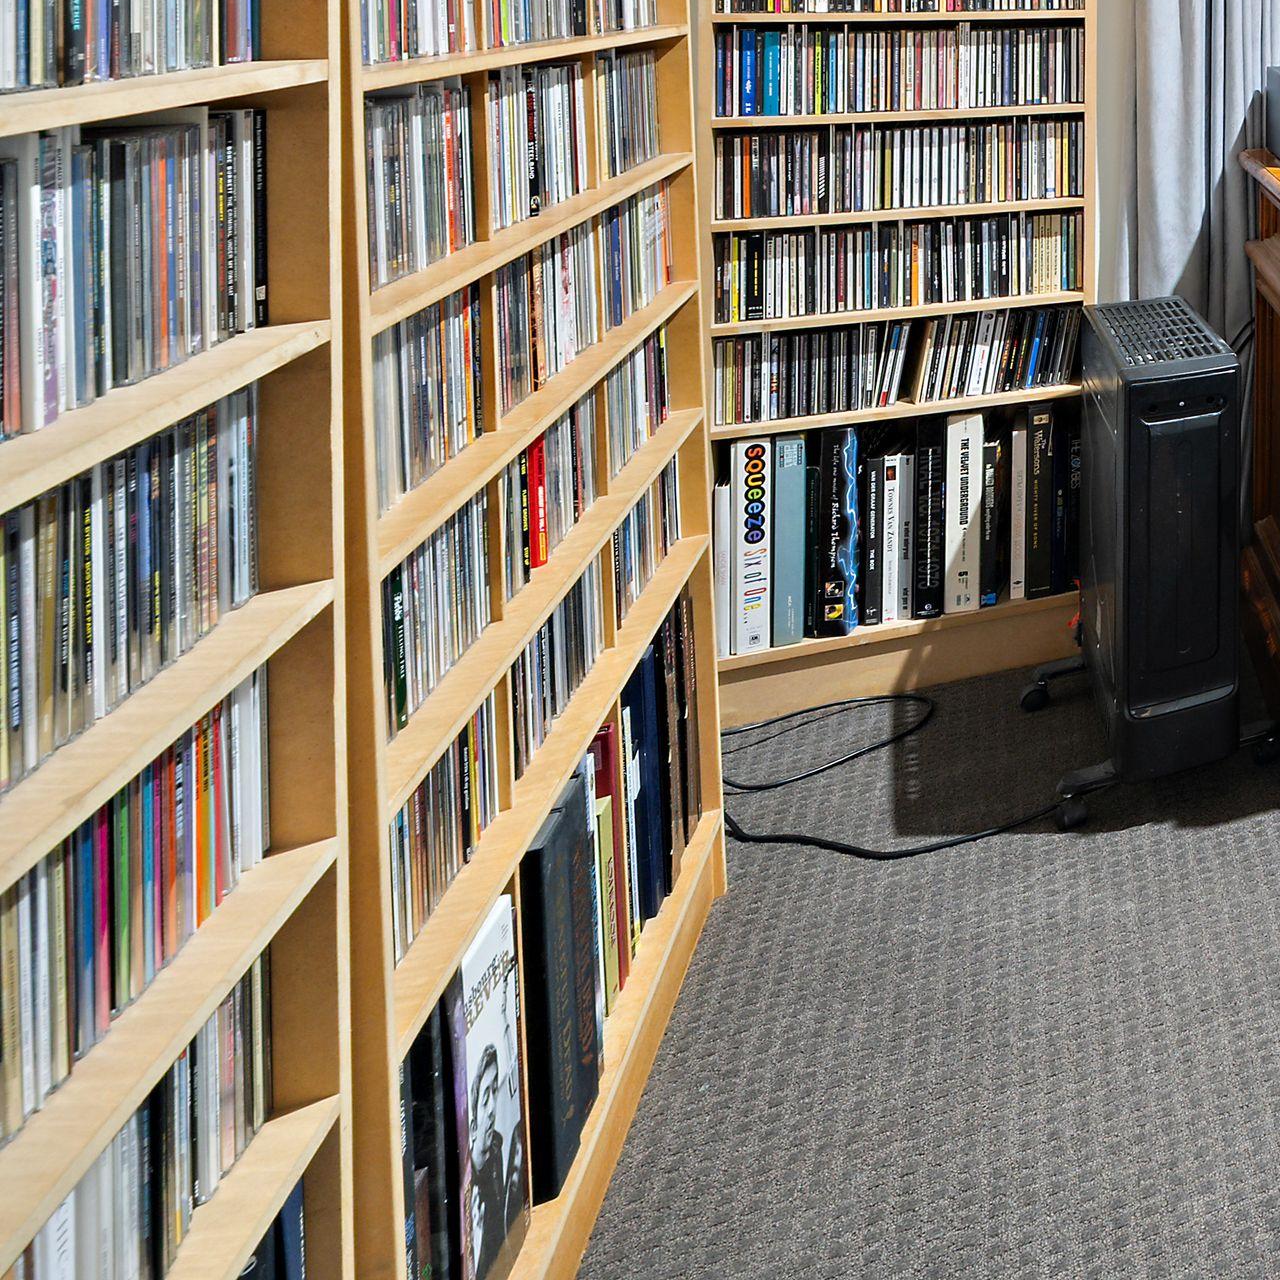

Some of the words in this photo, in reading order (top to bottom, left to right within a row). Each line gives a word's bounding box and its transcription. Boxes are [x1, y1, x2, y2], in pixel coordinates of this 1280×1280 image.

[960, 438, 970, 450] THE
[960, 452, 970, 476] VELVET
[744, 444, 766, 544] squeeze
[959, 476, 970, 525] UNDERGROUND
[831, 502, 840, 530] Richard
[745, 548, 768, 569] Six
[829, 532, 839, 569] Thompson
[745, 571, 767, 584] of
[744, 587, 767, 624] One...
